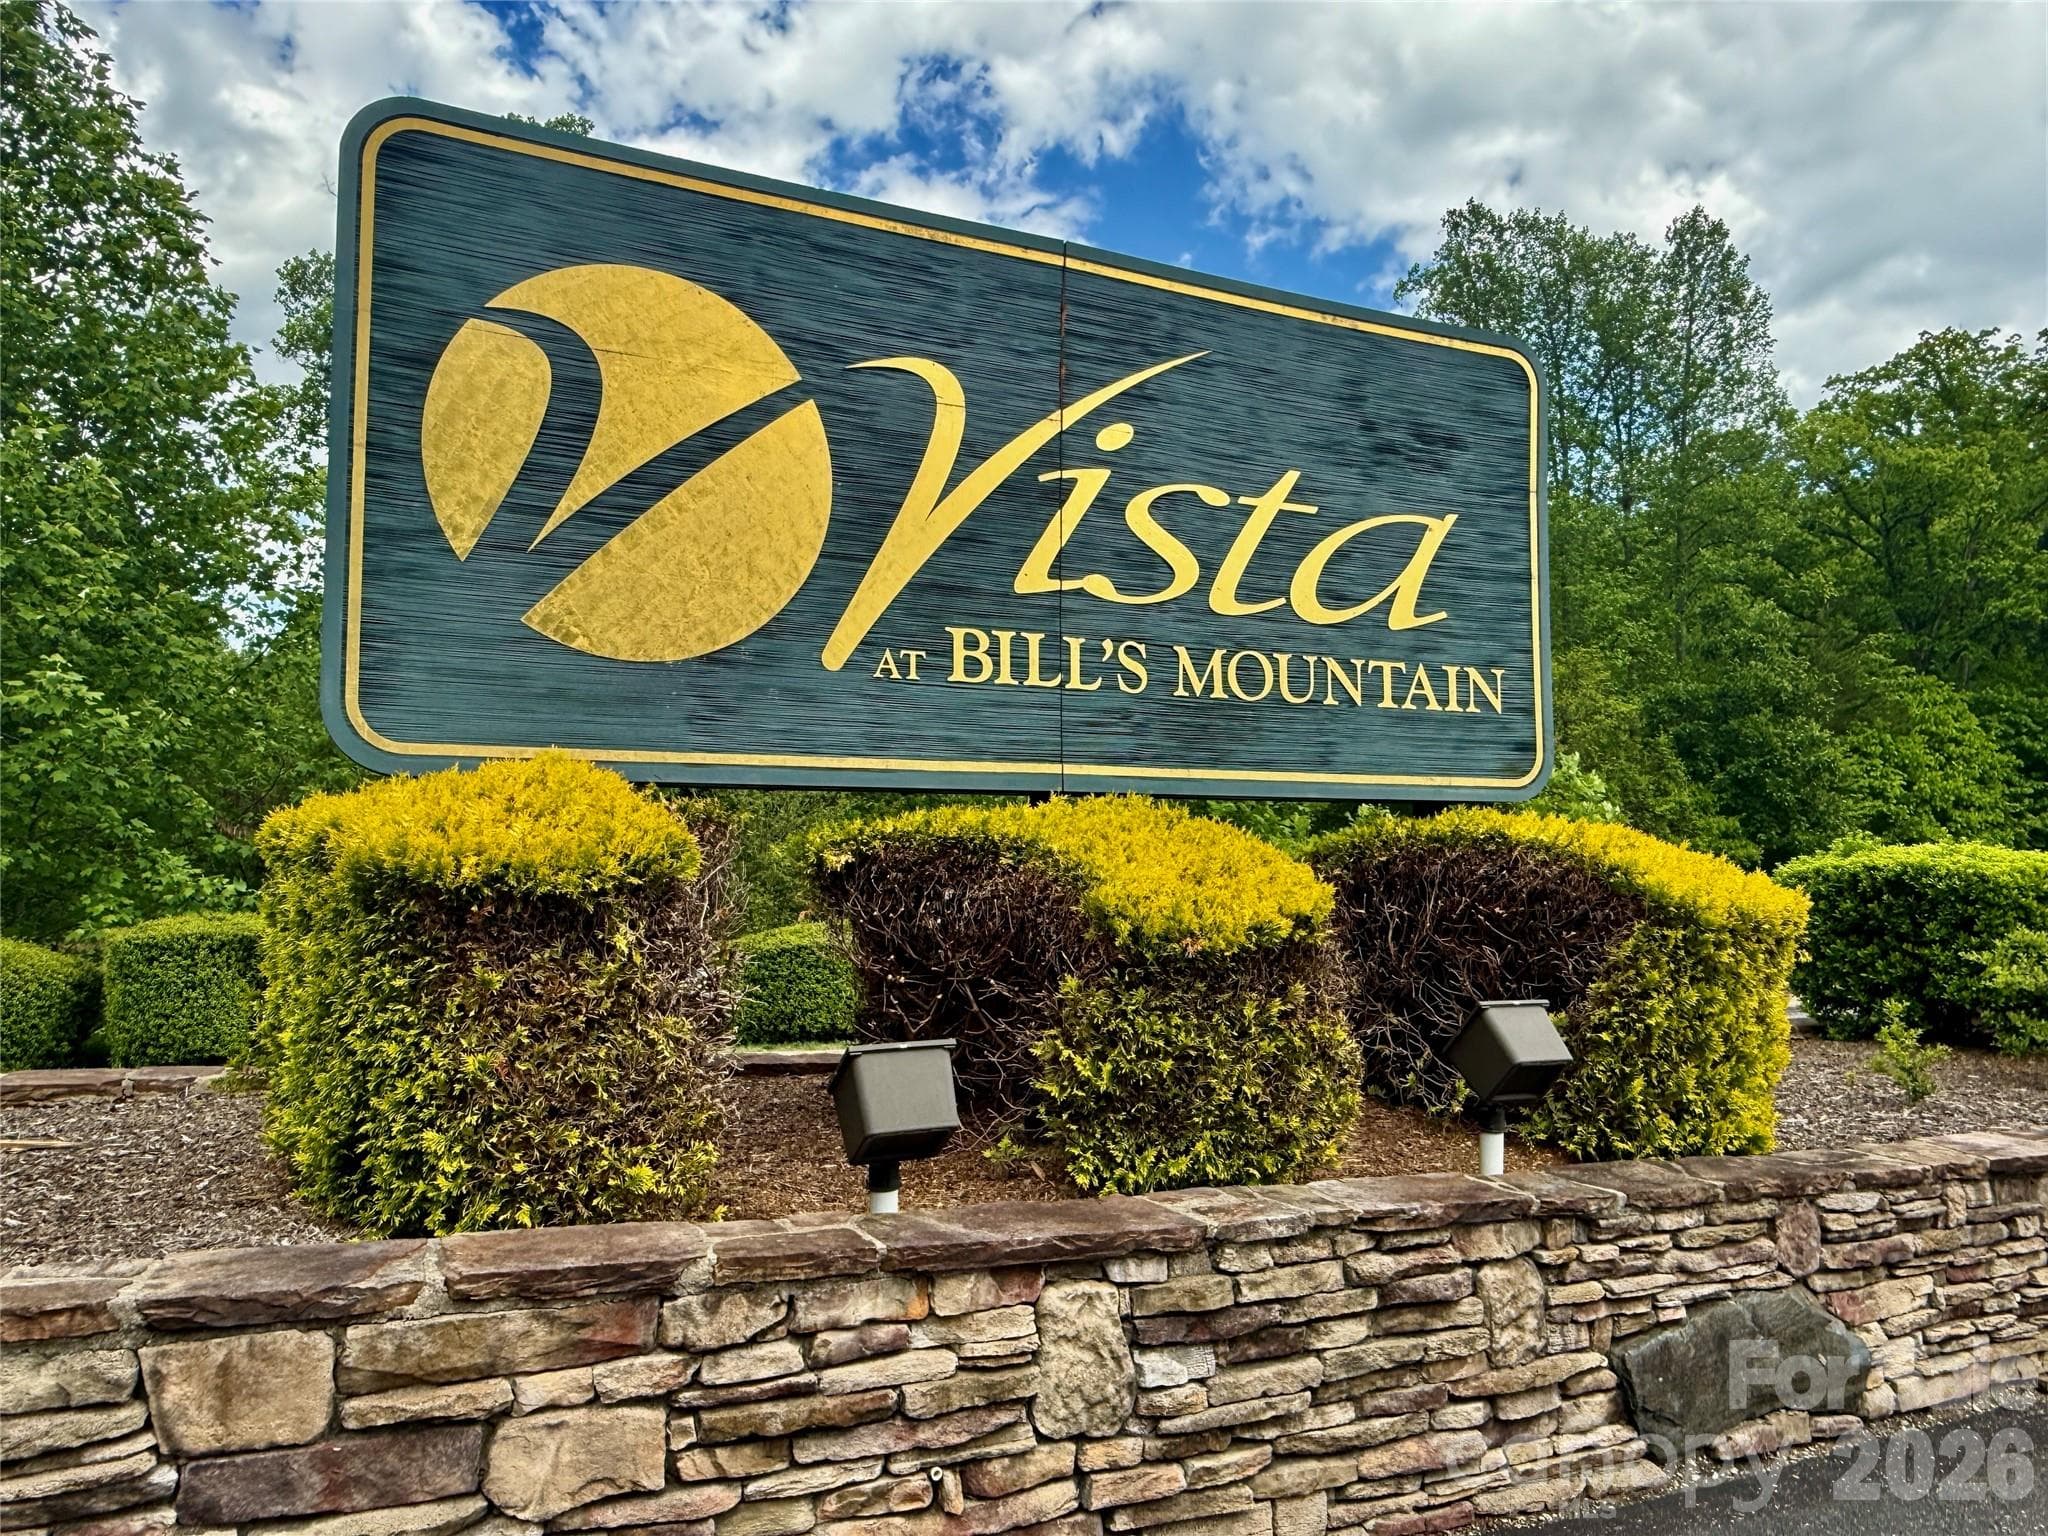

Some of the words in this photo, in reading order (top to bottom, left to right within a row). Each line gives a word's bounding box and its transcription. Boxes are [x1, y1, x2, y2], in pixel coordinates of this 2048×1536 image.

[823, 350, 1459, 672] Vista
[872, 648, 927, 681] AT
[946, 626, 1149, 692] BILL'S
[1174, 646, 1505, 714] MOUNTAIN
